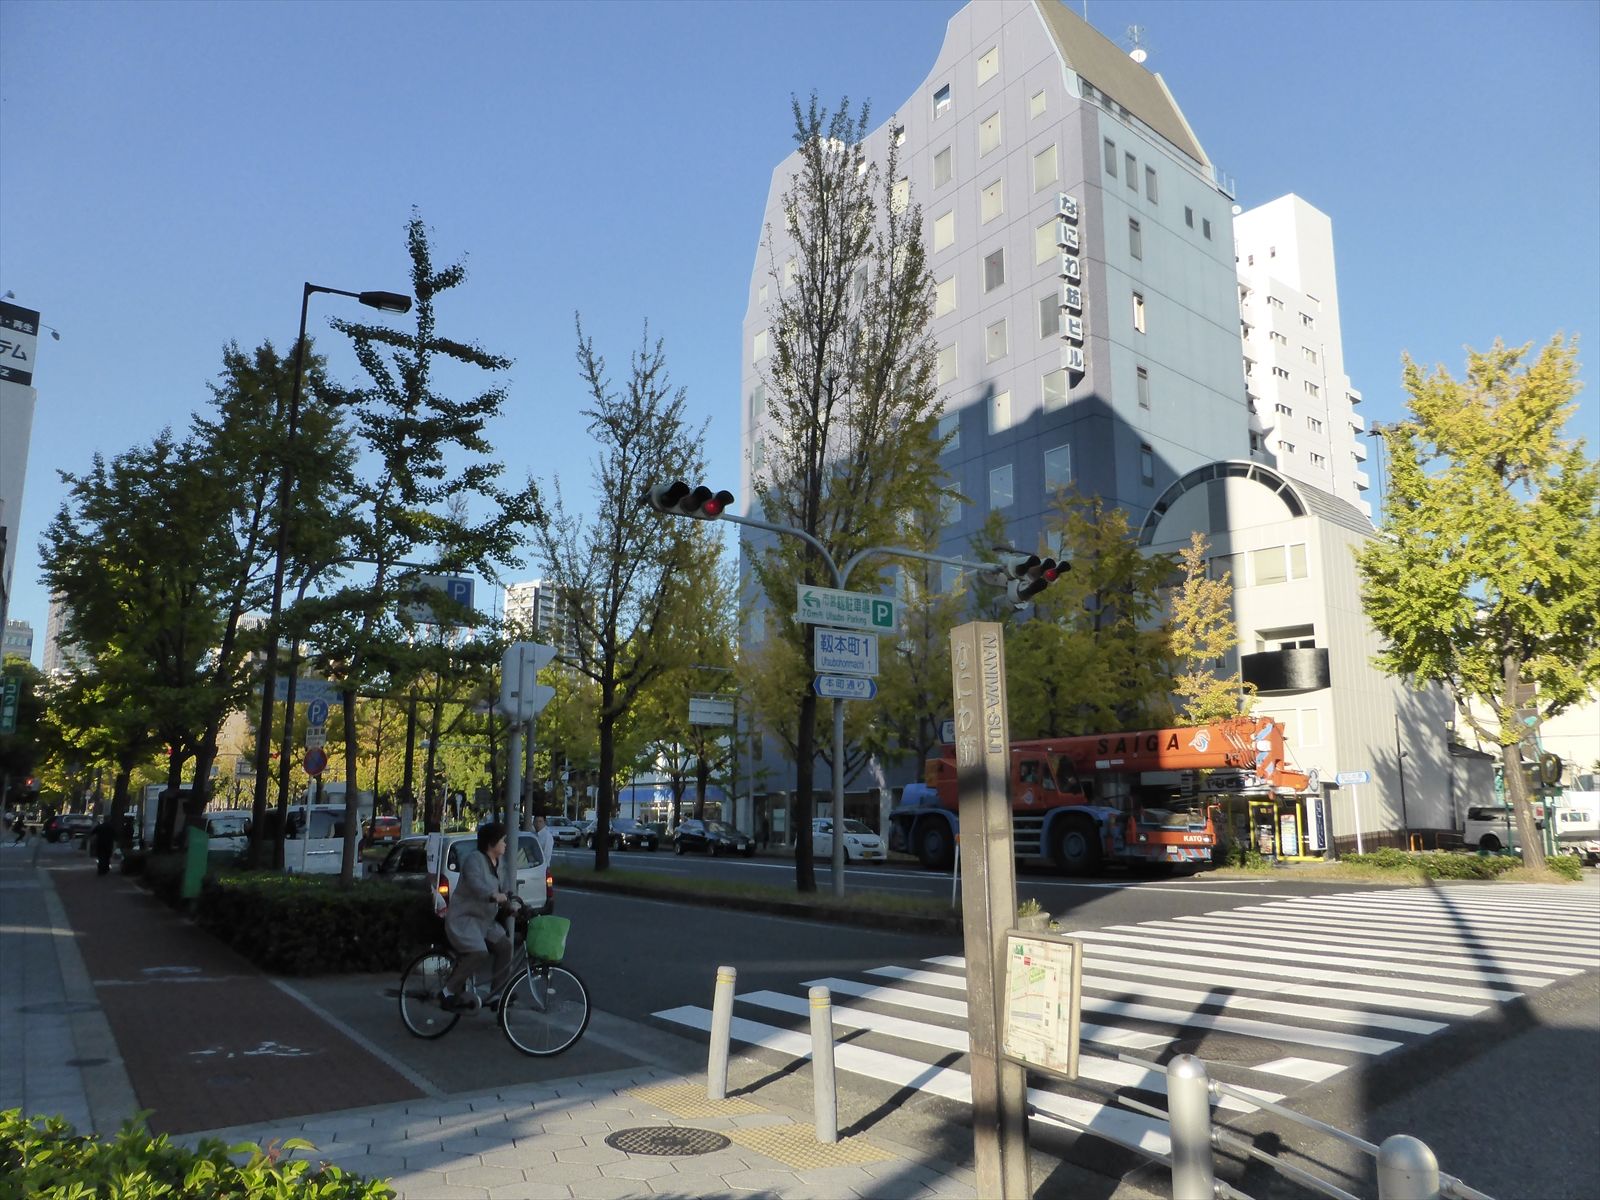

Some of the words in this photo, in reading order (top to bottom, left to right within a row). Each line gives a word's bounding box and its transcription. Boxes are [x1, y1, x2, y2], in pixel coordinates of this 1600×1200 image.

[1060, 196, 1082, 368] なにわ筋ビル
[825, 678, 865, 691] 本町通り
[955, 639, 977, 768] なにわ筋
[983, 633, 1001, 753] NANIWA-SUJI
[1097, 733, 1179, 755] SAIGA
